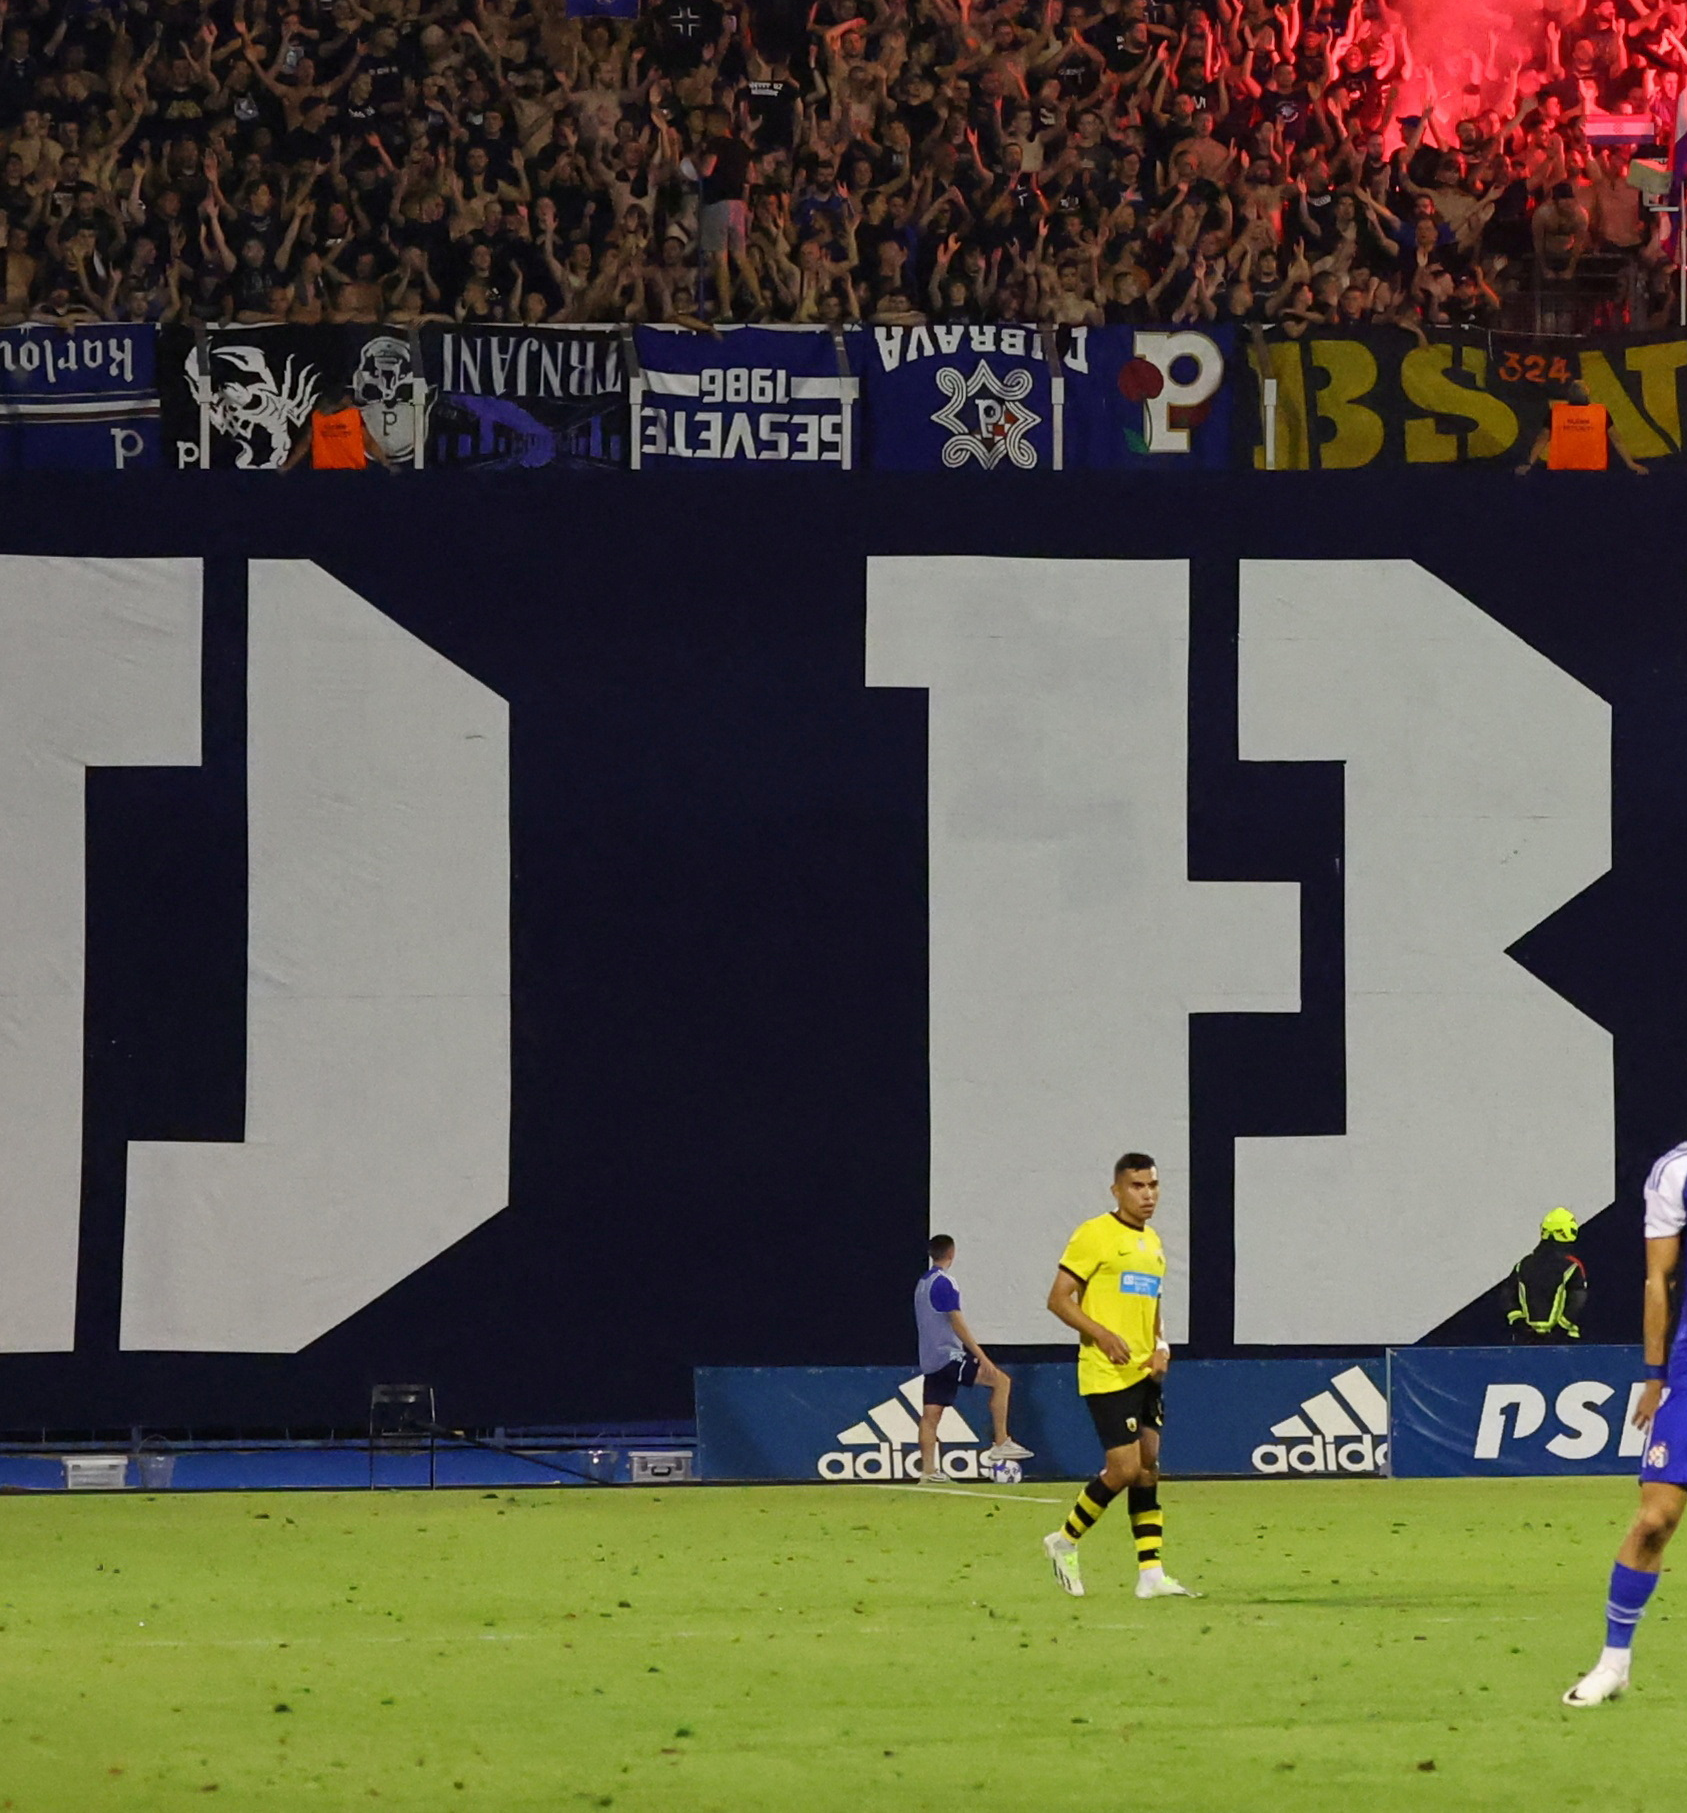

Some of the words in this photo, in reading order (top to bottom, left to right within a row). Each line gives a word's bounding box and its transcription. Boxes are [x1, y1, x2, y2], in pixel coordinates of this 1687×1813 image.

[442, 332, 623, 397] TRNJANI
[699, 367, 790, 404] 1986
[640, 406, 842, 461] SESVETE
